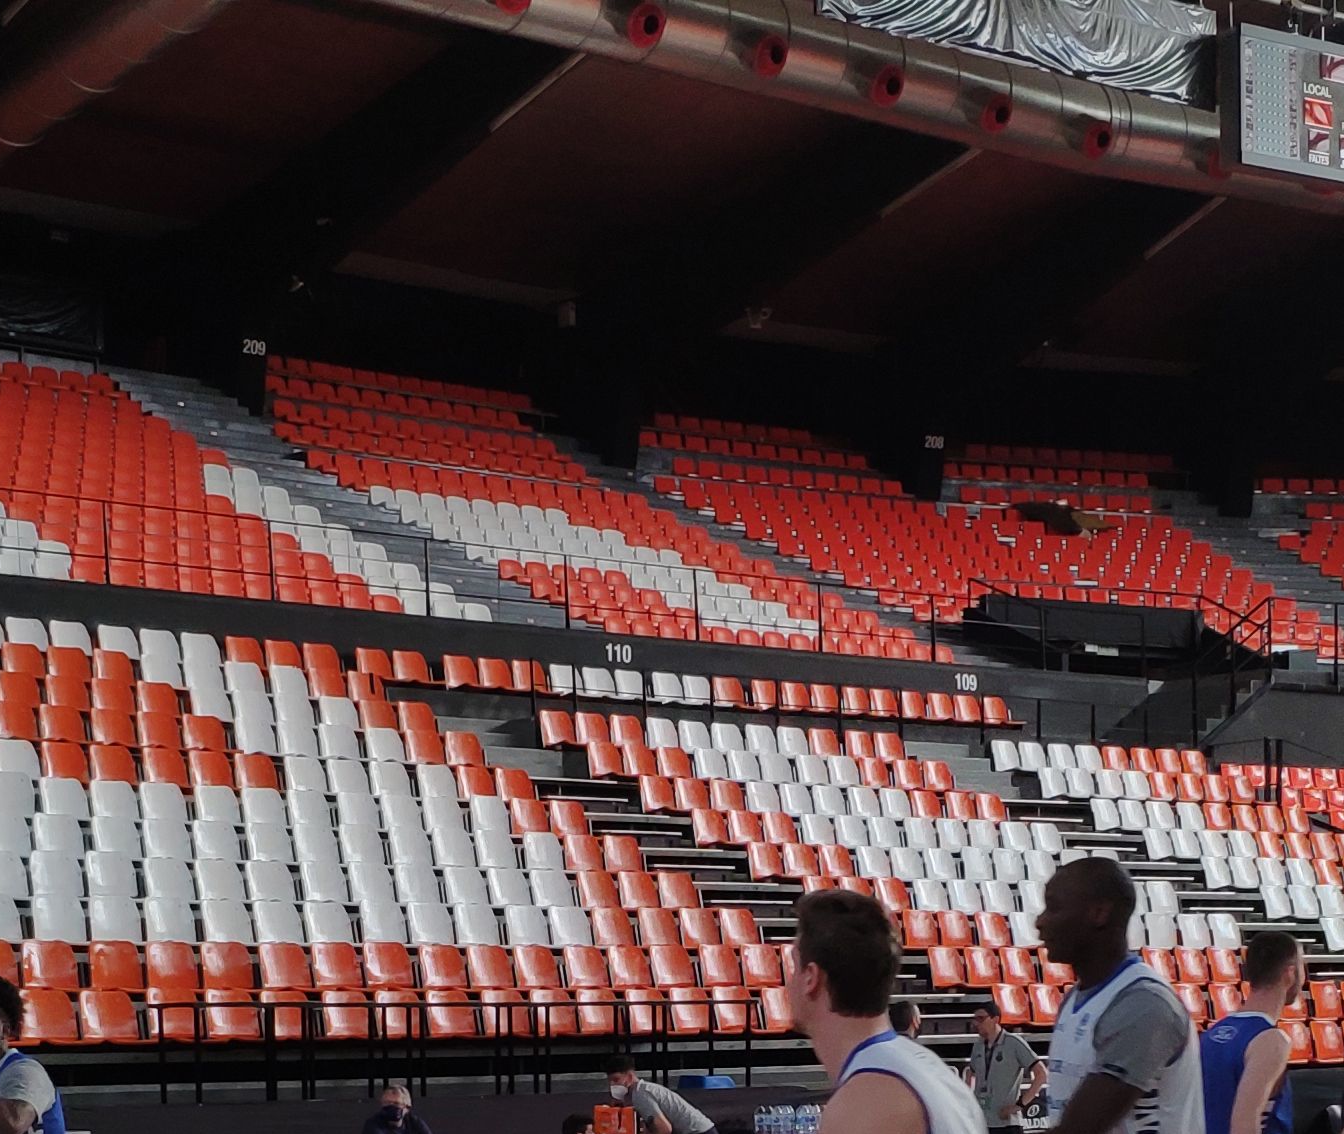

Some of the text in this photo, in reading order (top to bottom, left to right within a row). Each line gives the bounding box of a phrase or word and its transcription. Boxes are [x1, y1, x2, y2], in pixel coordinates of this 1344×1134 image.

[1303, 82, 1332, 98] LOCAL
[242, 338, 266, 356] 209
[924, 435, 945, 450] 208
[605, 642, 632, 663] 110
[954, 672, 978, 692] 109
